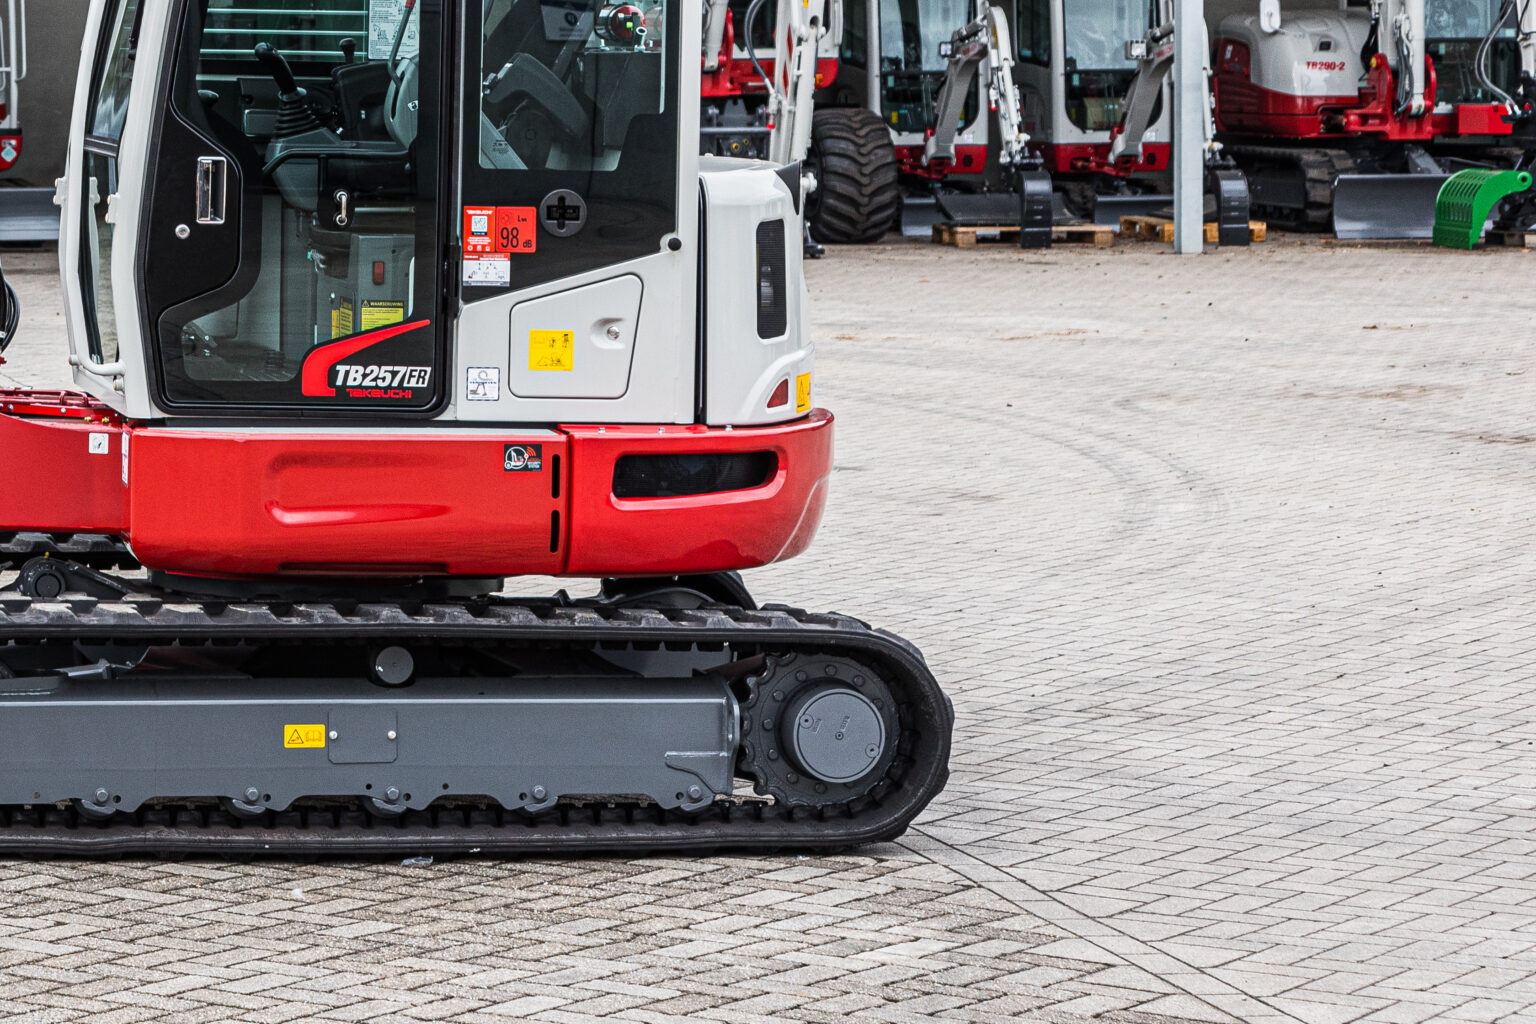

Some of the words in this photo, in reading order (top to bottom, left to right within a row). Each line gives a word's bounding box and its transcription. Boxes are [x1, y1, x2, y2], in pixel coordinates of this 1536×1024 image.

[500, 226, 520, 249] 98
[522, 239, 533, 249] dB
[345, 388, 412, 399] TAKEUCHI
